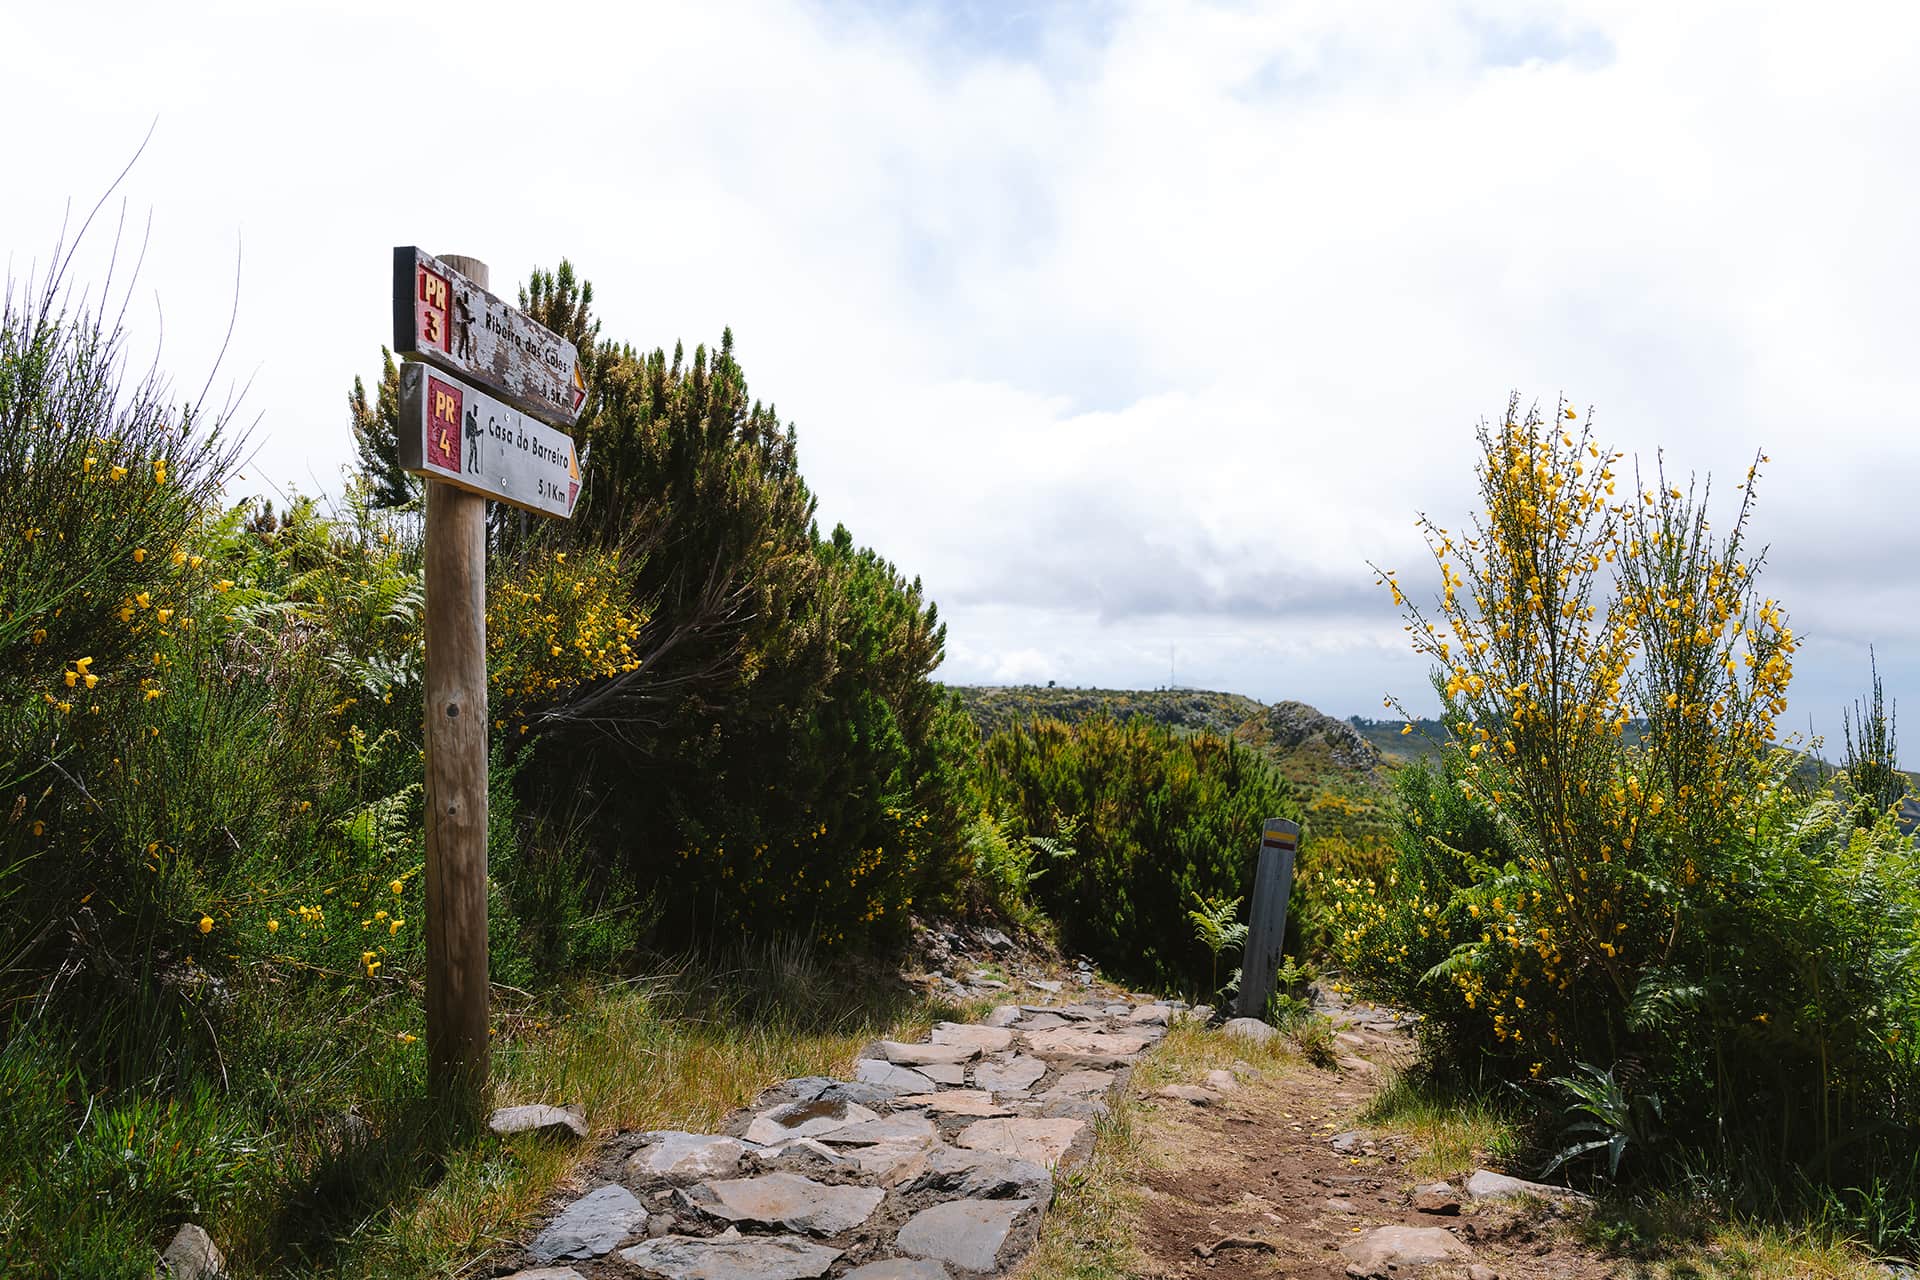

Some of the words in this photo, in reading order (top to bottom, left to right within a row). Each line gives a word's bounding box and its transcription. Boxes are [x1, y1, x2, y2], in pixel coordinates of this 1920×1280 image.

[424, 273, 447, 311] PR
[424, 310, 441, 342] 3
[486, 312, 521, 347] Ribeira
[525, 337, 541, 358] das
[435, 390, 455, 424] PR
[439, 429, 451, 458] 4
[488, 416, 513, 443] Casa
[517, 428, 529, 451] do
[532, 437, 569, 469] Barreiro
[538, 479, 566, 503] 5,1Km
